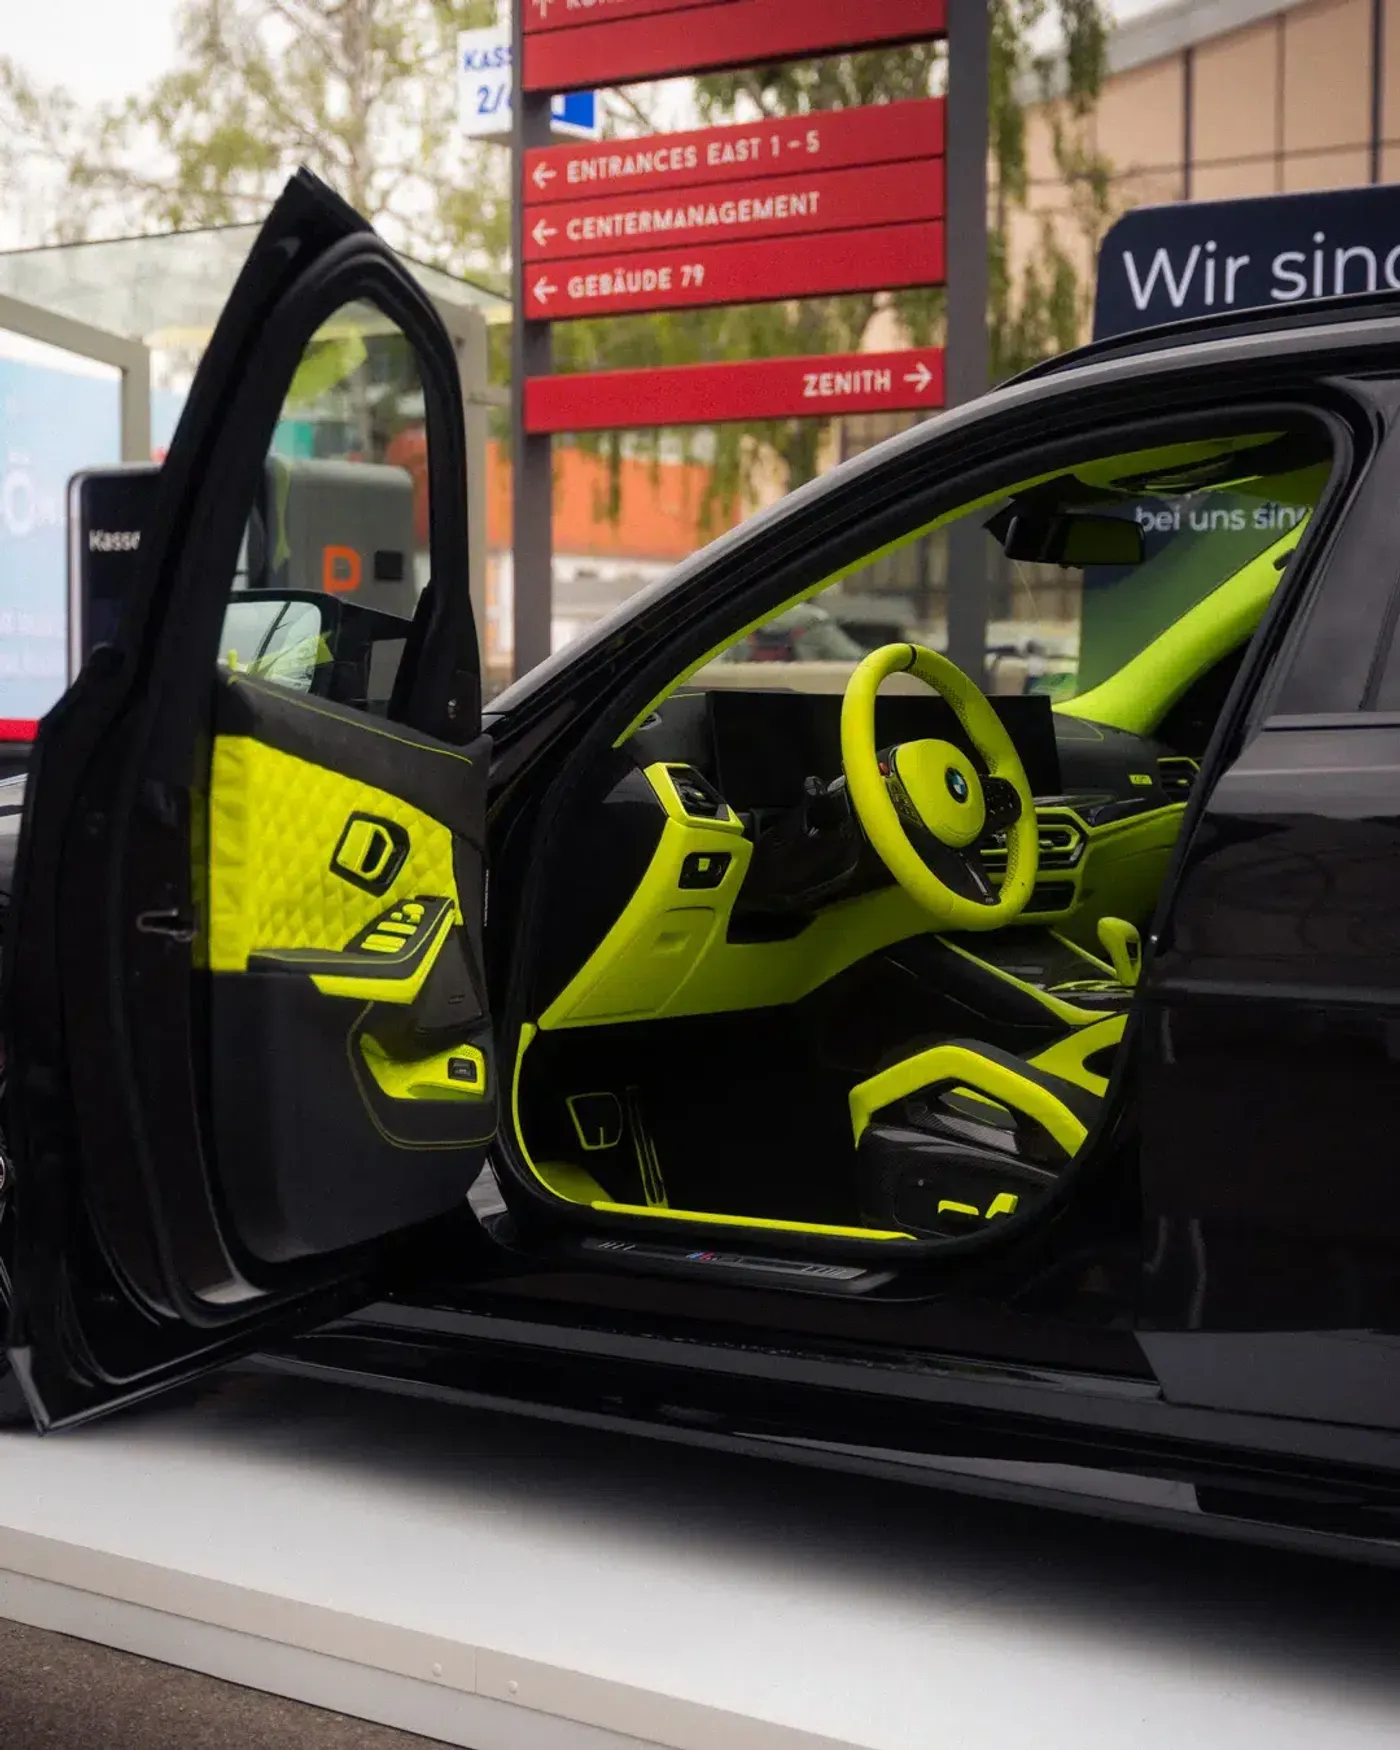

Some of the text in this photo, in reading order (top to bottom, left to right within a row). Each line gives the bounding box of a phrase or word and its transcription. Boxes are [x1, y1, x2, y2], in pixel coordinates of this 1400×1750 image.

[567, 145, 698, 183] ENTRANCES
[707, 137, 762, 166] EAST
[770, 135, 780, 157] 1
[566, 191, 821, 240] CENTERMANAGEMENT
[567, 264, 705, 298] GEBÄUDE 79
[1122, 239, 1250, 310] Wir
[803, 368, 892, 397] ZENITH
[1136, 505, 1181, 531] bei
[1189, 509, 1246, 531] uns
[322, 544, 363, 593] D
